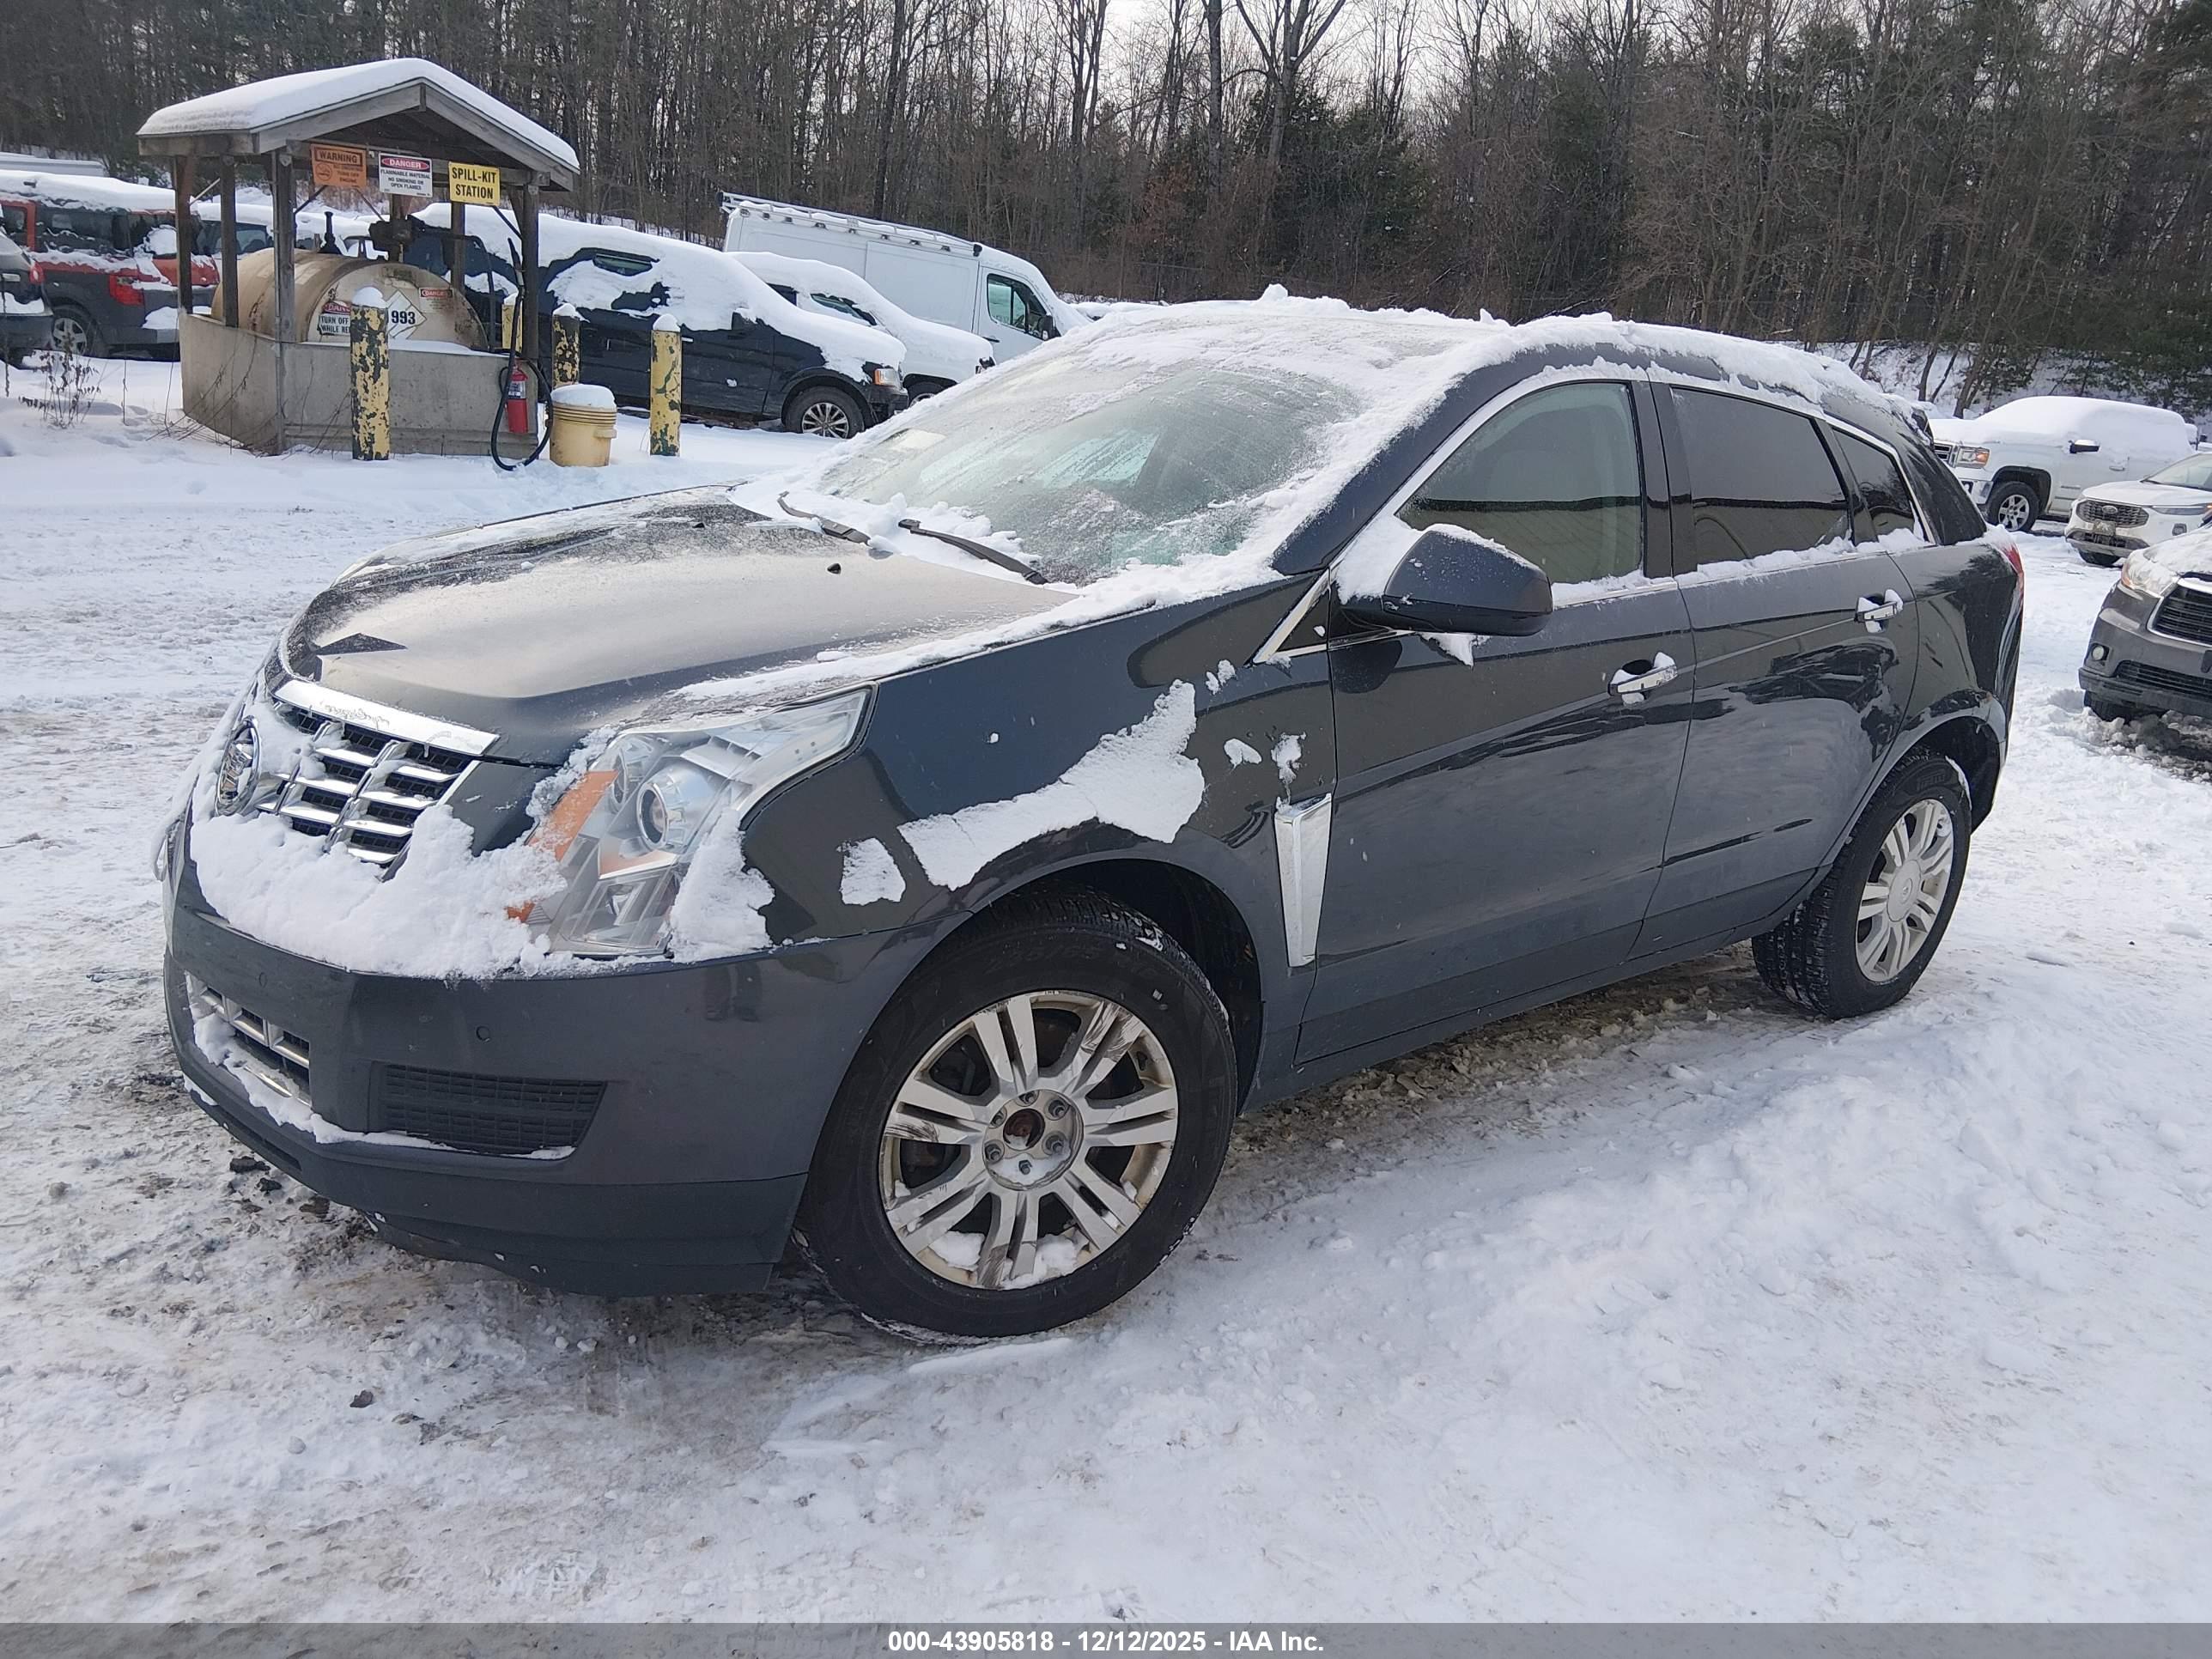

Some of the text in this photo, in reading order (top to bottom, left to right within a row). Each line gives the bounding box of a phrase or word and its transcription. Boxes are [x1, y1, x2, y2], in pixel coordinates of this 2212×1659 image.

[319, 150, 357, 163] WARNING
[389, 159, 421, 170] DANGER
[452, 167, 496, 184] SPILL-KIT
[455, 184, 493, 199] STATION
[328, 304, 349, 313] DAN
[321, 316, 336, 325] TURN
[391, 310, 416, 325] 993
[321, 325, 339, 333] WHILE
